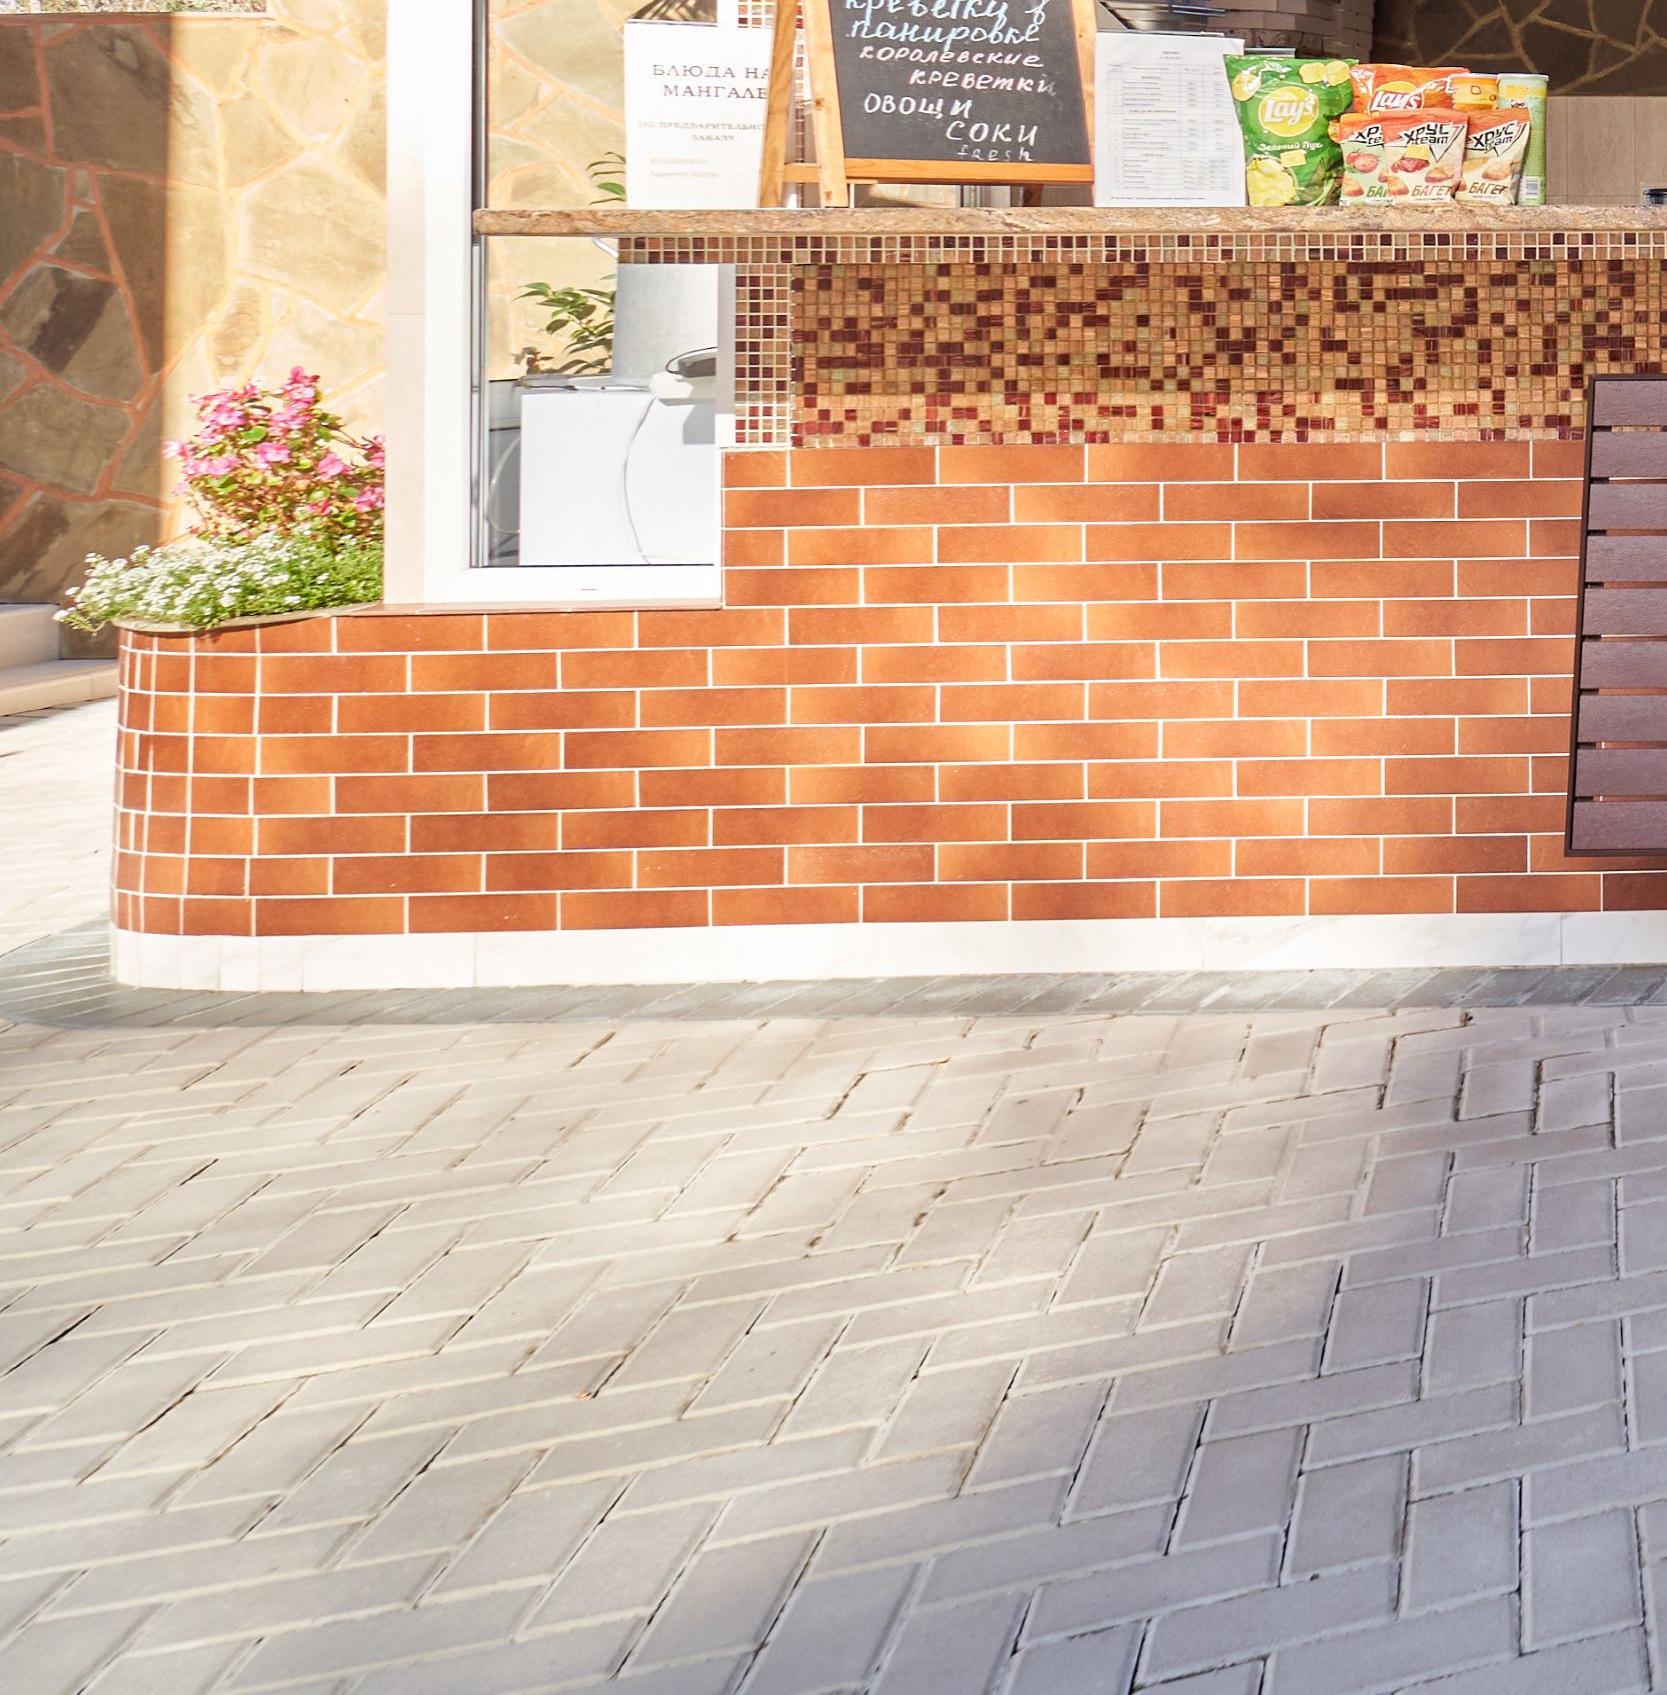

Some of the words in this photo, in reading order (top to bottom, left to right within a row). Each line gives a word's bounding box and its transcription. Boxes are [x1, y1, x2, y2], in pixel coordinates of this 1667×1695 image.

[849, 17, 1040, 51] панировке
[652, 64, 736, 79] БЛЮДА
[864, 92, 972, 119] ОВОЩИ
[659, 122, 765, 131] ПРЕДВАРИТЕЛЬНО
[946, 120, 1038, 146] СОКИ
